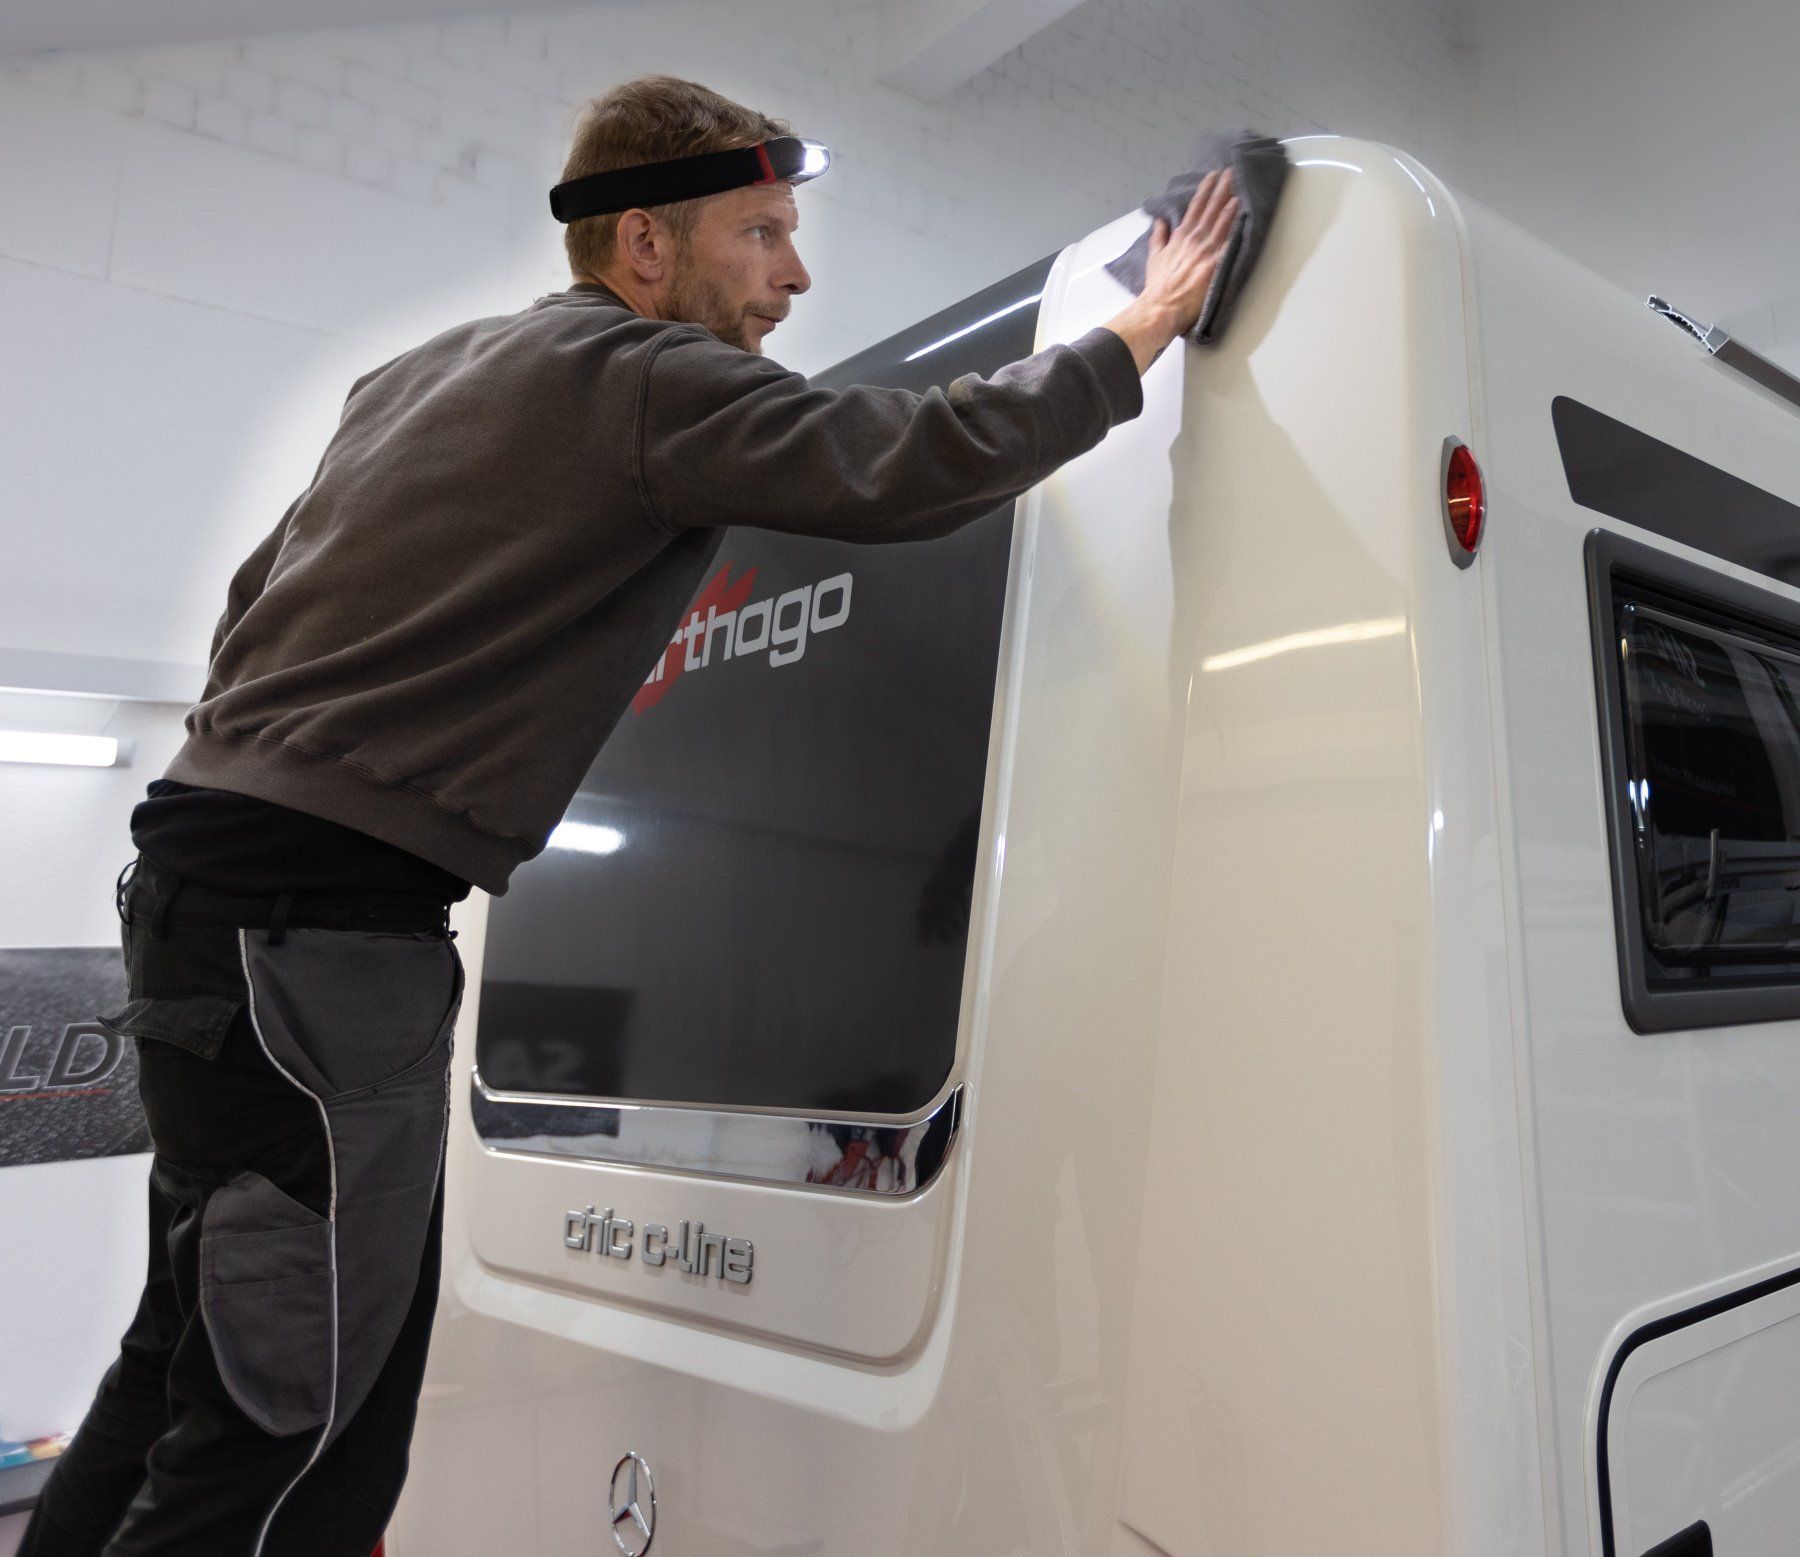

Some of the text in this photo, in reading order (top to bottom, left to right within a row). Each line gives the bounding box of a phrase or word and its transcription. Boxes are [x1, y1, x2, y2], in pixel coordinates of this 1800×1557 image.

[643, 572, 853, 685] rthago
[564, 1205, 754, 1284] chic c-line
